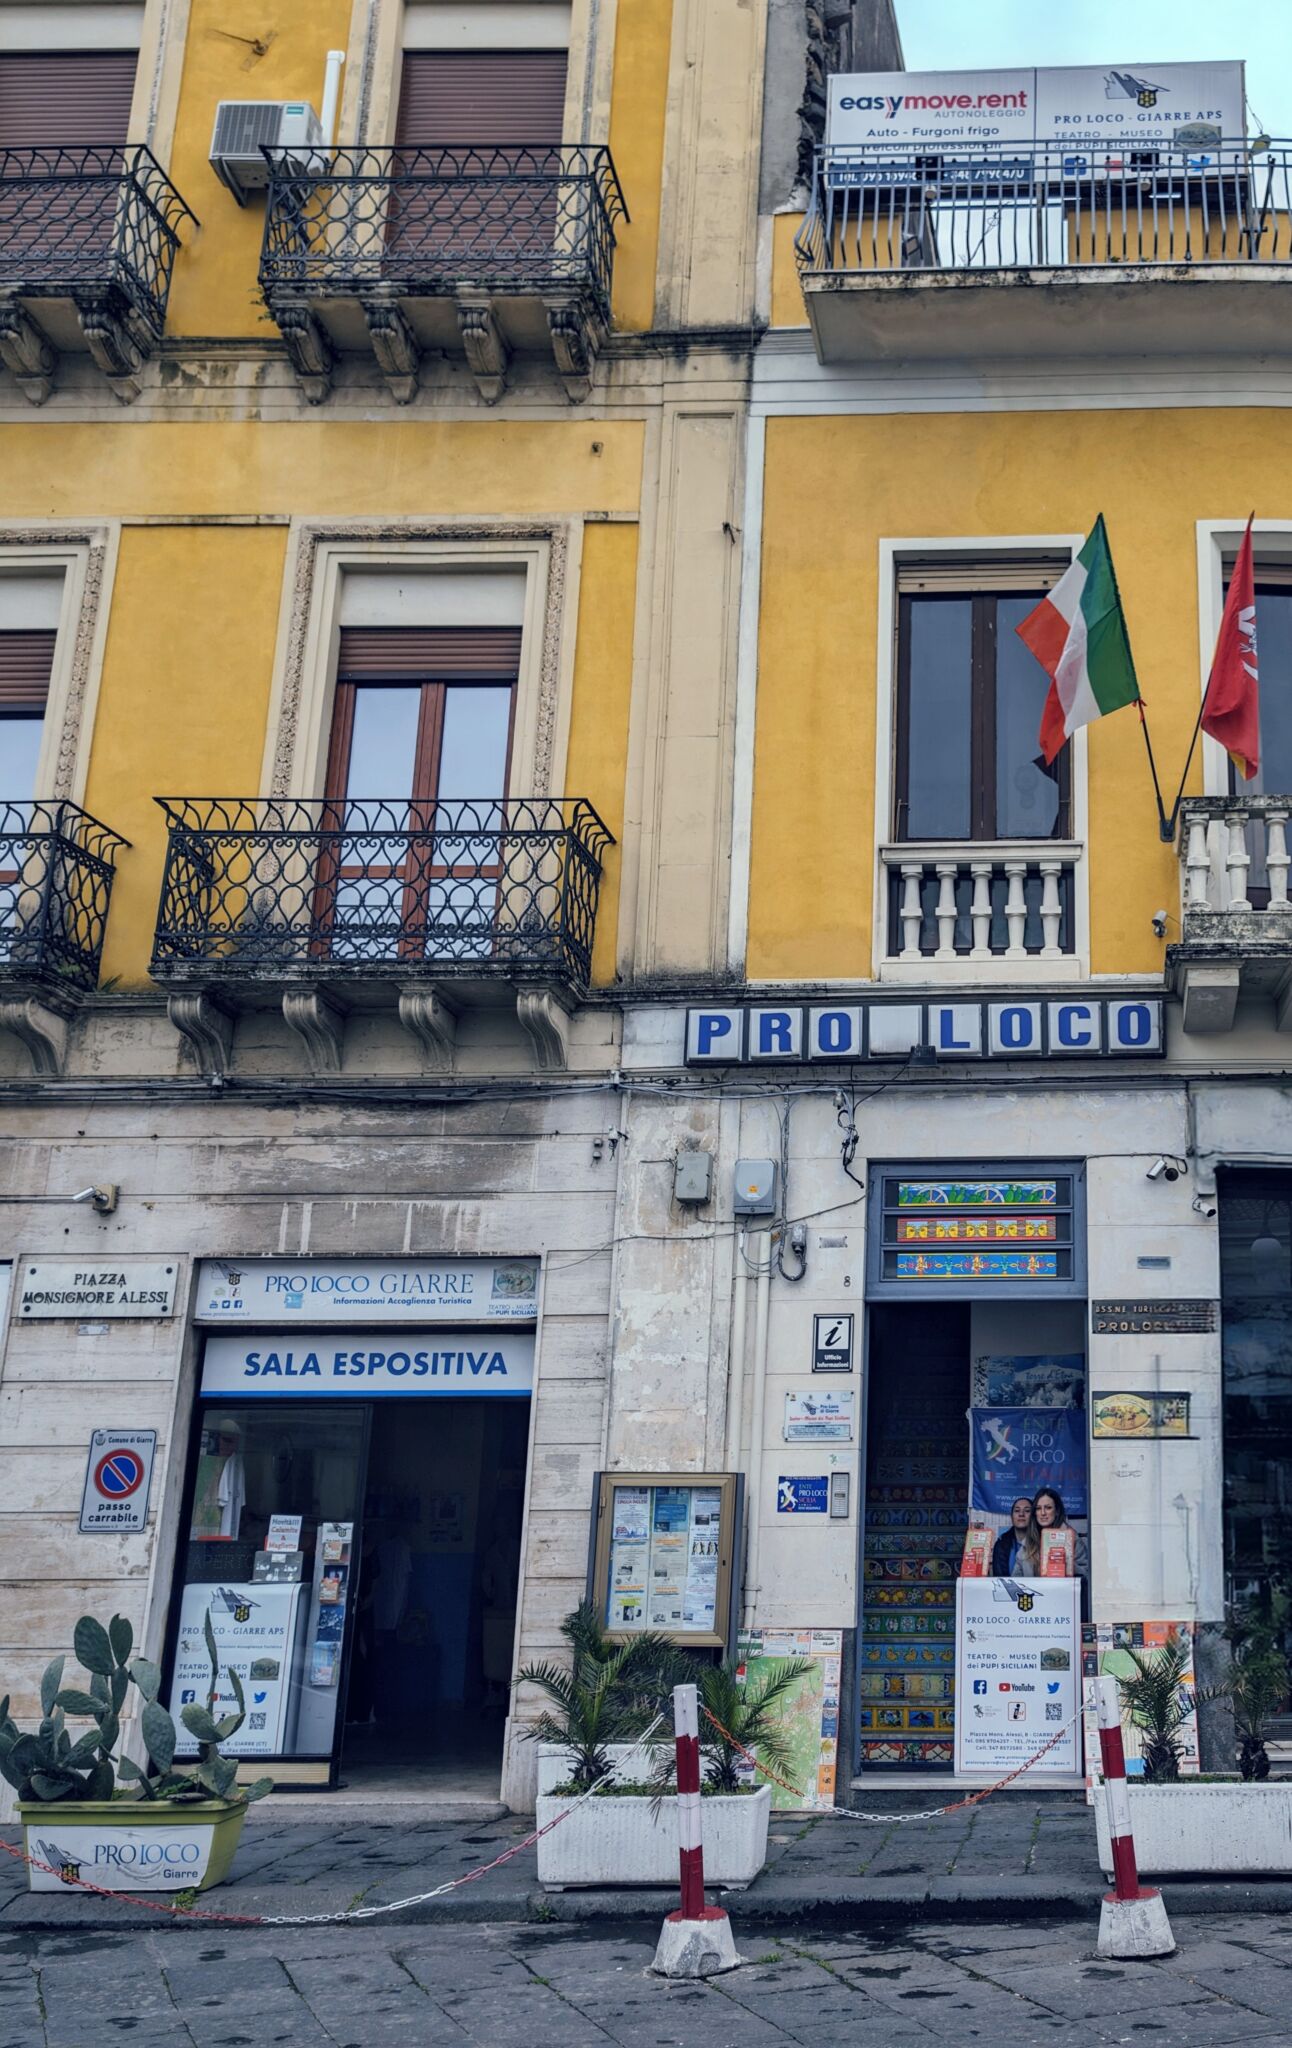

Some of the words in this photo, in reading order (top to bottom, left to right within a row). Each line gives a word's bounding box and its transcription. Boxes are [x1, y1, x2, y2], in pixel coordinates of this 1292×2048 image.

[840, 91, 1027, 119] easymove.rent
[934, 109, 1026, 119] AUTONOLEGGIO
[1054, 115, 1082, 124] PRO
[1087, 114, 1124, 123] LOCO
[1137, 112, 1191, 122] GIARRE
[1196, 110, 1222, 120] APS
[866, 128, 899, 137] Auto
[912, 126, 964, 138] Furgoni
[968, 125, 999, 137] frigo
[1055, 131, 1101, 139] TEATRO
[697, 1011, 853, 1055] PRO
[939, 1005, 1151, 1049] LOCO
[73, 1273, 127, 1287] PIAZZA
[379, 1273, 474, 1294] GIARRE
[843, 1275, 851, 1287] 8
[22, 1291, 115, 1304] MONSIGNORE
[118, 1291, 168, 1303] ALESSI
[333, 1296, 385, 1304] Informazioni
[387, 1297, 436, 1306] Accoglienza
[243, 1352, 321, 1376] SALA
[333, 1352, 508, 1376] ESPOSITIVA
[1022, 1433, 1053, 1447] PRO
[1022, 1450, 1065, 1463] LOCO
[98, 1503, 131, 1512] passo
[88, 1513, 138, 1522] carrabile
[966, 1616, 983, 1624] PRO
[986, 1616, 1010, 1624] LOCO
[1018, 1616, 1051, 1624] GIARRE
[1054, 1616, 1071, 1624] APS
[182, 1627, 199, 1635] PRO
[233, 1627, 266, 1635] GIARRE
[268, 1627, 284, 1635] APS
[1011, 1683, 1035, 1692] YouTube
[163, 1868, 199, 1879] Giarre
